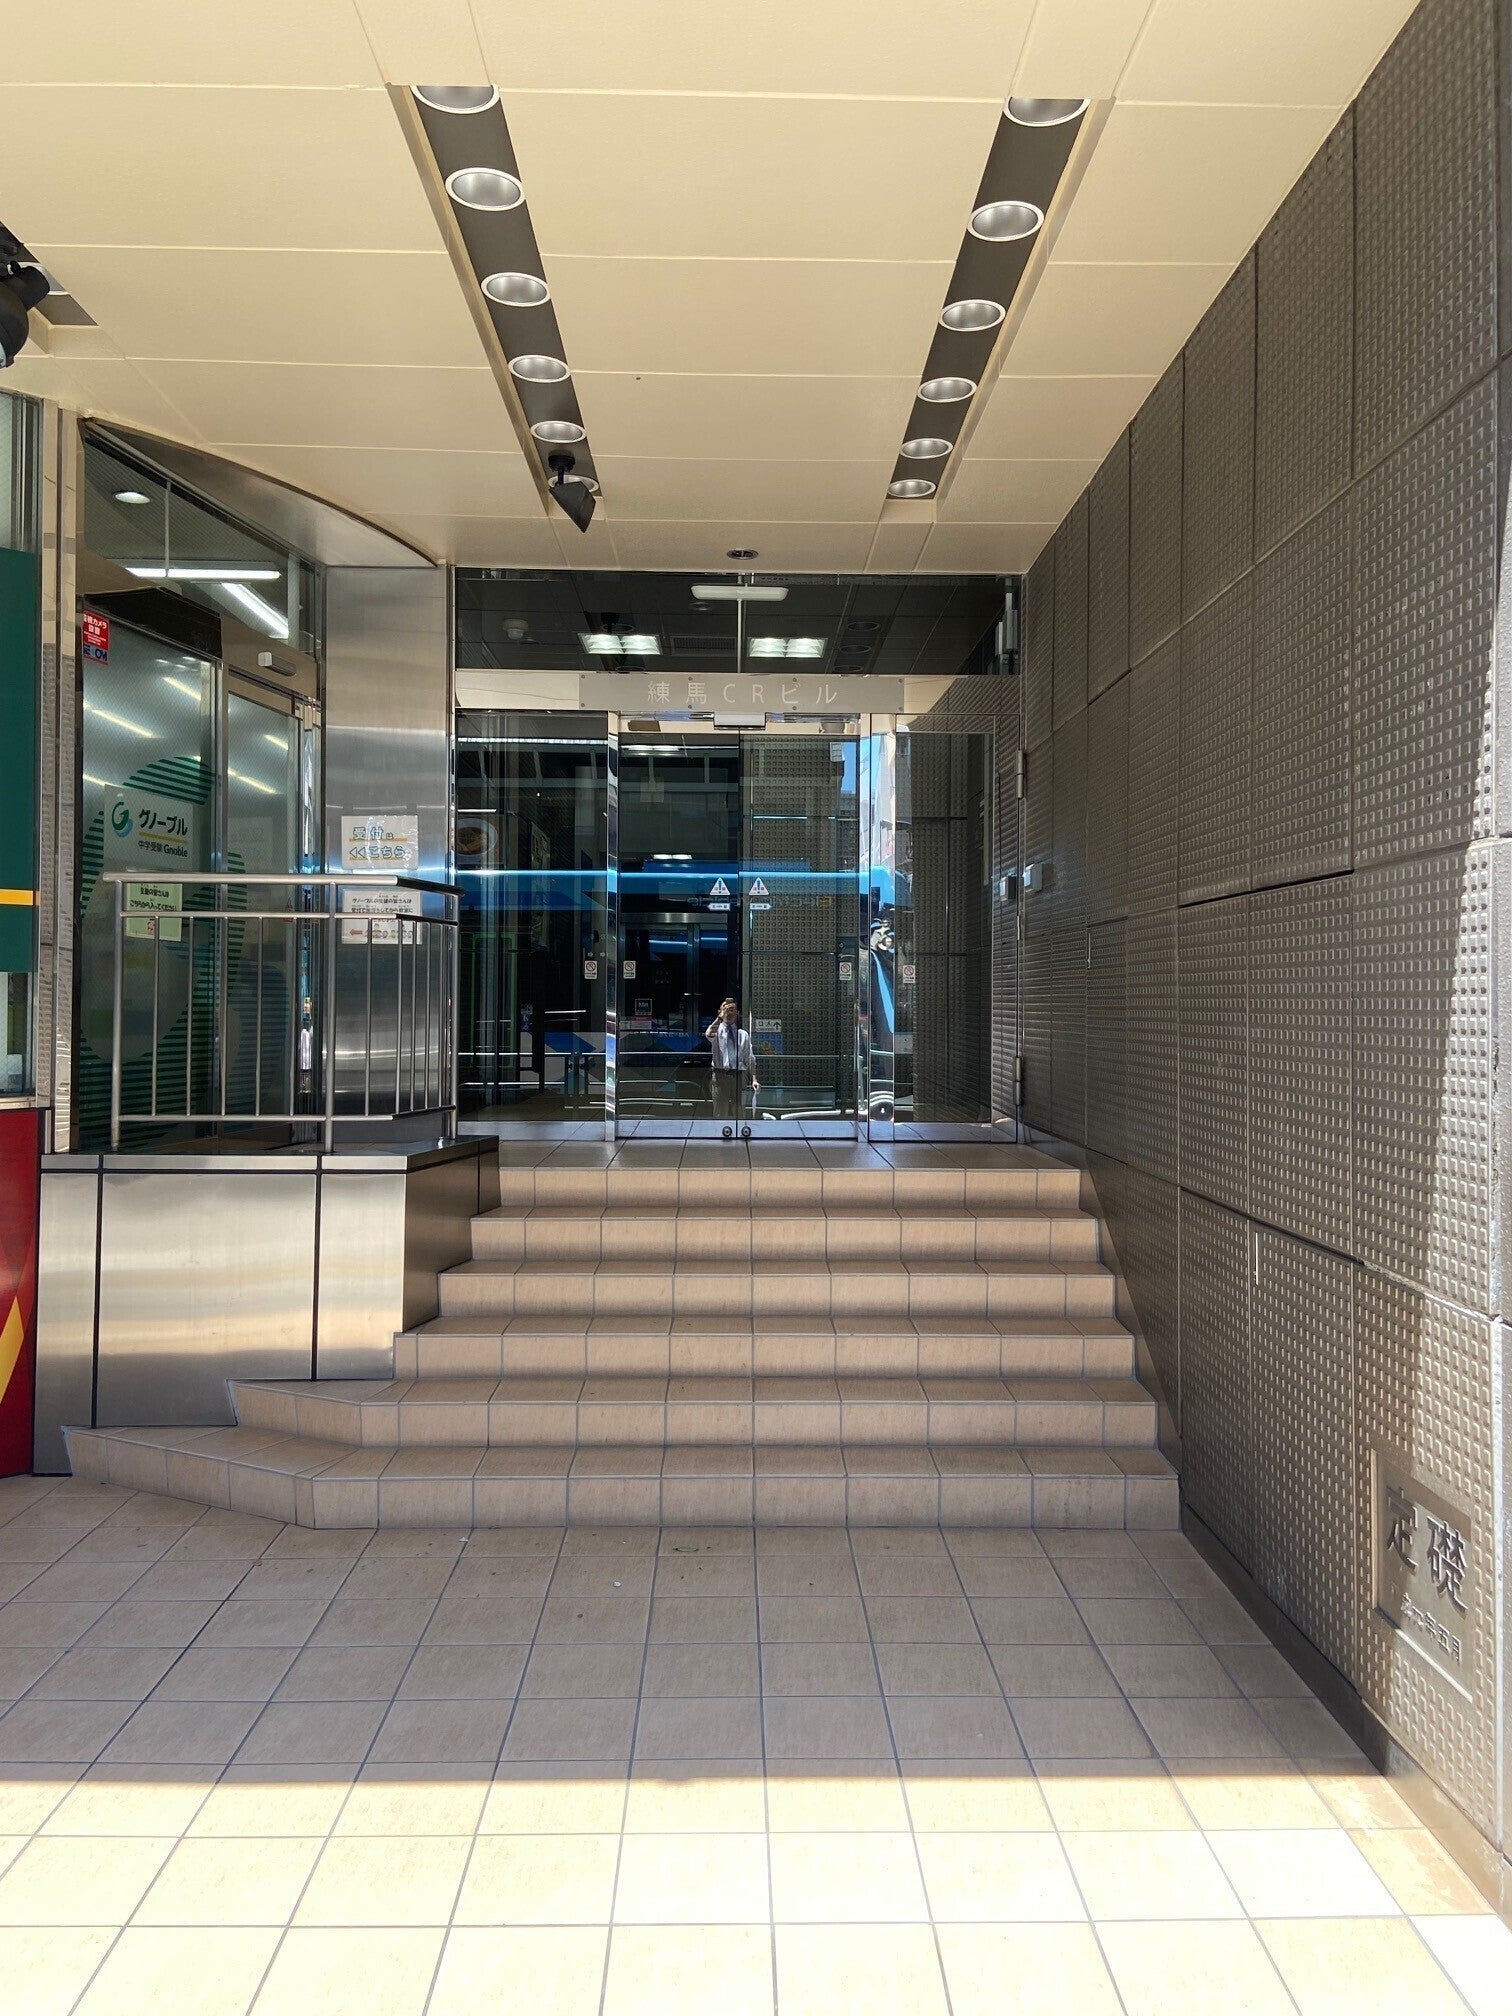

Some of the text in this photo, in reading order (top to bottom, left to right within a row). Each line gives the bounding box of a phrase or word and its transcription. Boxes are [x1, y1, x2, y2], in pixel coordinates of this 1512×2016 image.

[647, 680, 838, 705] 練馬CRビル
[139, 808, 188, 836] グノーブル
[353, 826, 394, 841] 受付は
[138, 840, 188, 858] 中学受験 Gnoble
[369, 845, 406, 860] こちら
[1386, 1485, 1469, 1610] 定礎
